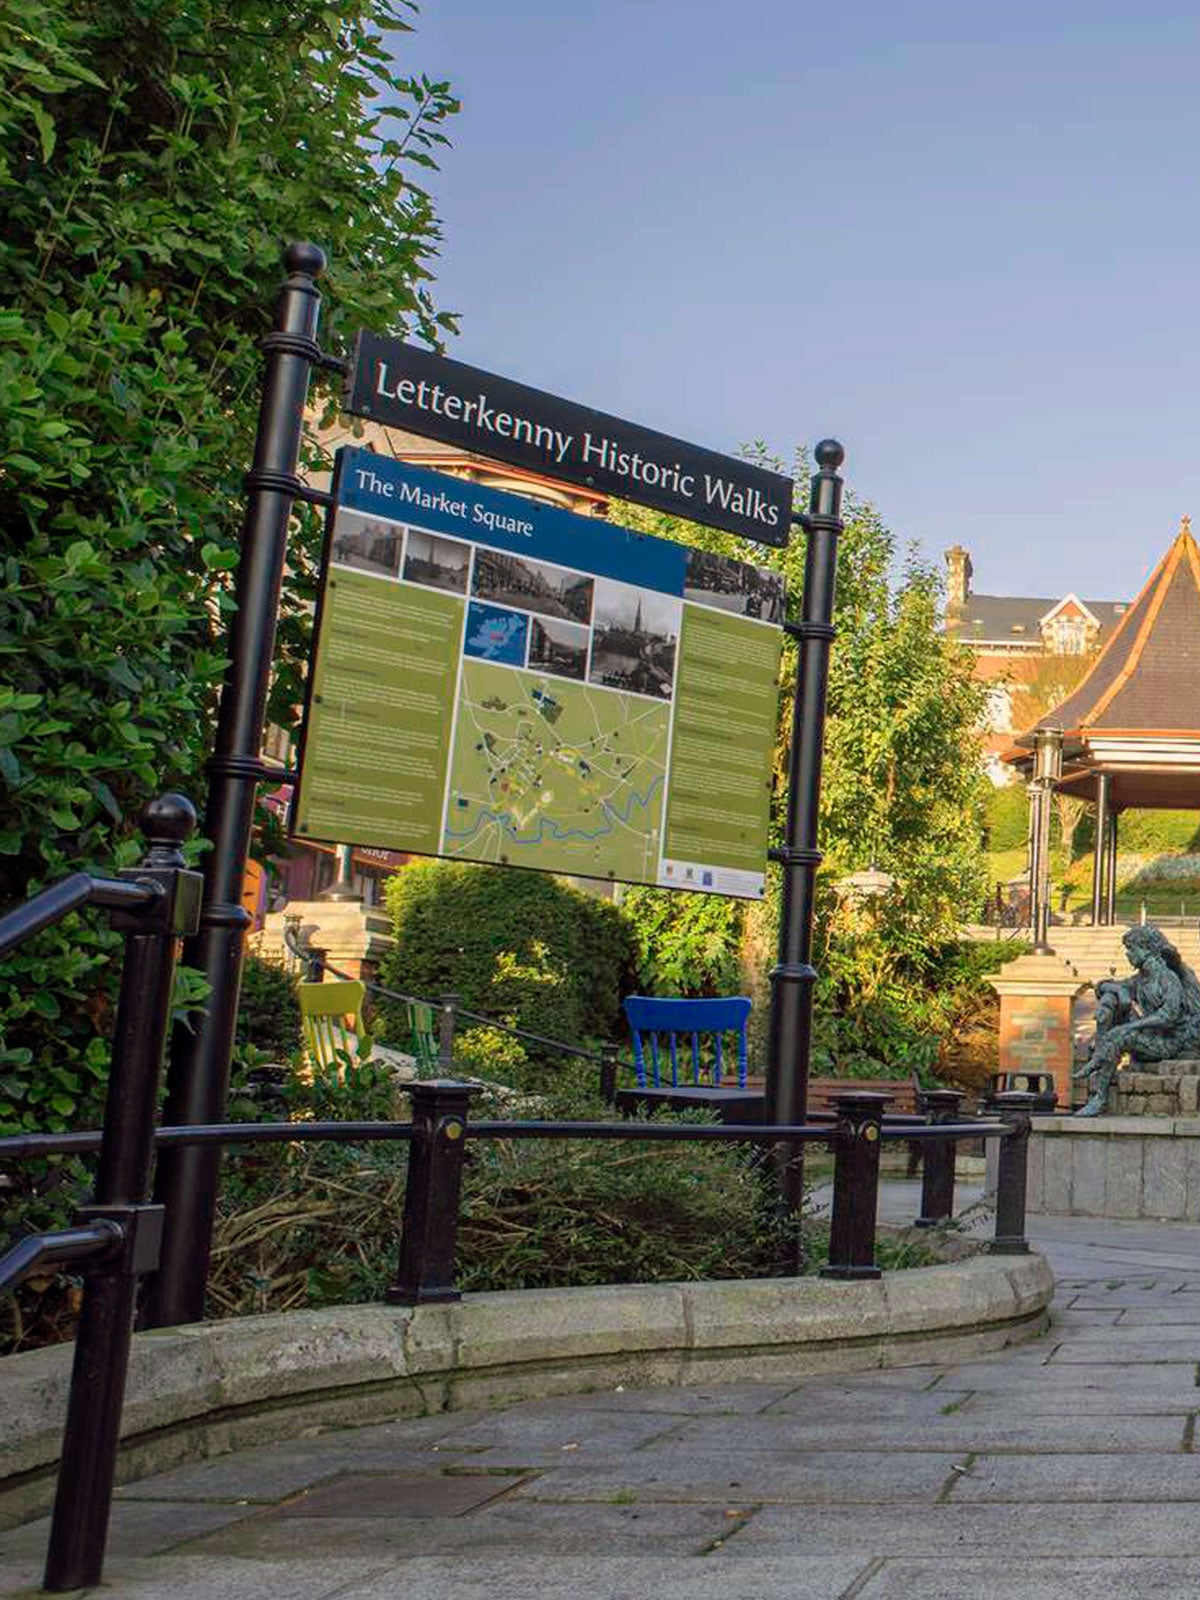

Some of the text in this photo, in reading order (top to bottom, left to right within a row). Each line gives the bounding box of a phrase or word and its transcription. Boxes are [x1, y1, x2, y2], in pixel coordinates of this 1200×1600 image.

[376, 361, 780, 526] Letterkenny Historic Walks
[356, 469, 534, 538] The Market Square
